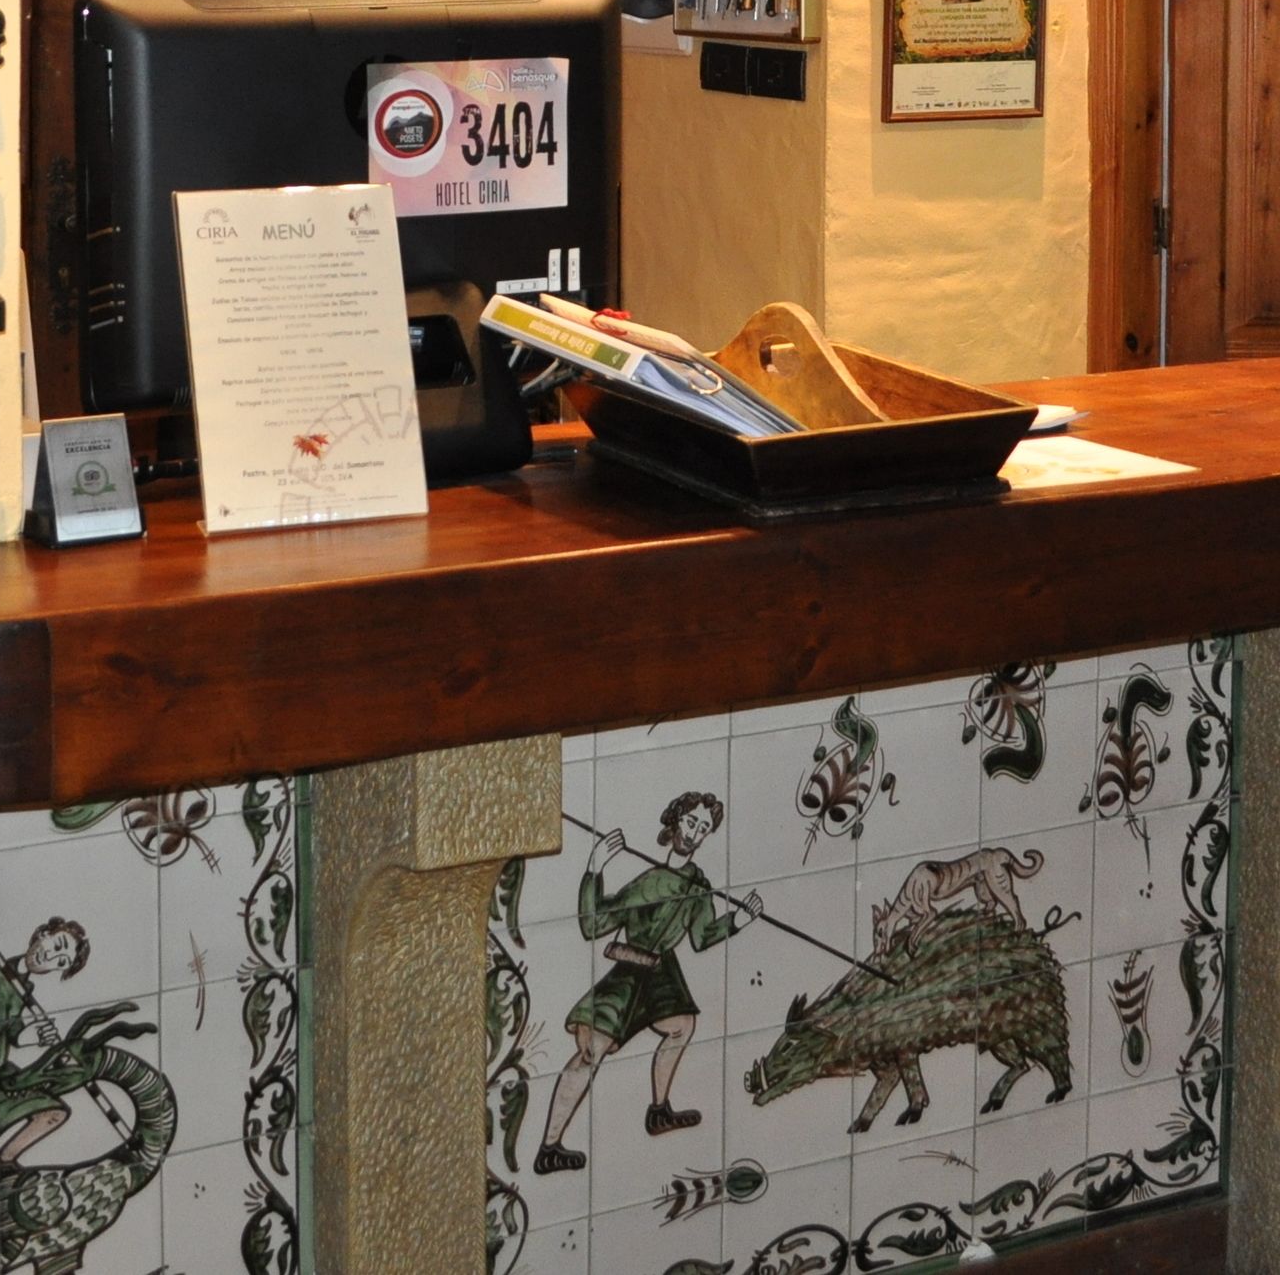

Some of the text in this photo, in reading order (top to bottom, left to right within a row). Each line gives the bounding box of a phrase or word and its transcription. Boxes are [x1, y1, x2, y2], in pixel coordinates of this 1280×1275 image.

[510, 72, 558, 86] benasque
[459, 101, 558, 169] 3404
[436, 179, 510, 207] HOTEL CIRIA
[196, 226, 239, 239] CIRIA
[262, 218, 315, 240] MENÚ
[64, 444, 112, 454] EXCELENCIA
